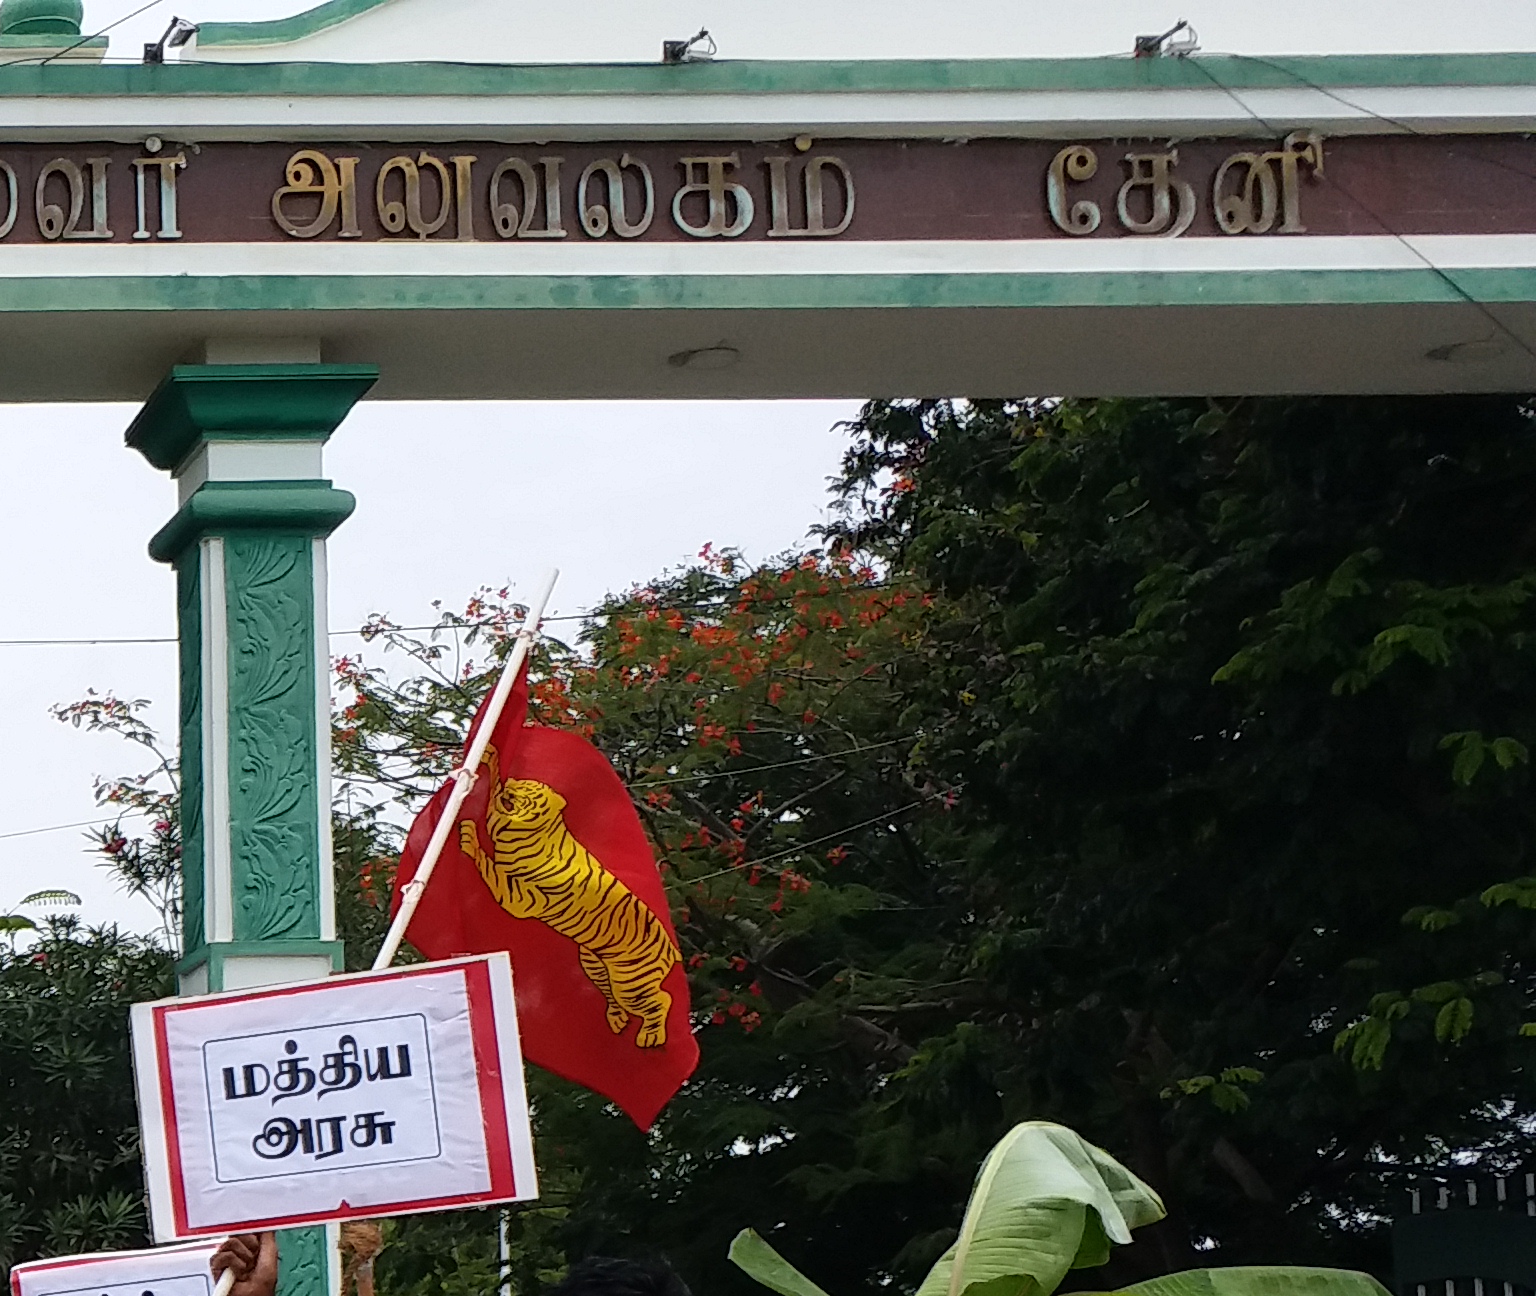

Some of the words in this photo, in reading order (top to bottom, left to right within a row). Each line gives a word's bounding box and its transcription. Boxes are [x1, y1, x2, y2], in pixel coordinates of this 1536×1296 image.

[271, 134, 856, 242] அலுவலகம்
[1047, 130, 1324, 237] தேனி
[222, 1035, 412, 1107] மத்திய
[253, 1111, 396, 1161] அரசு
